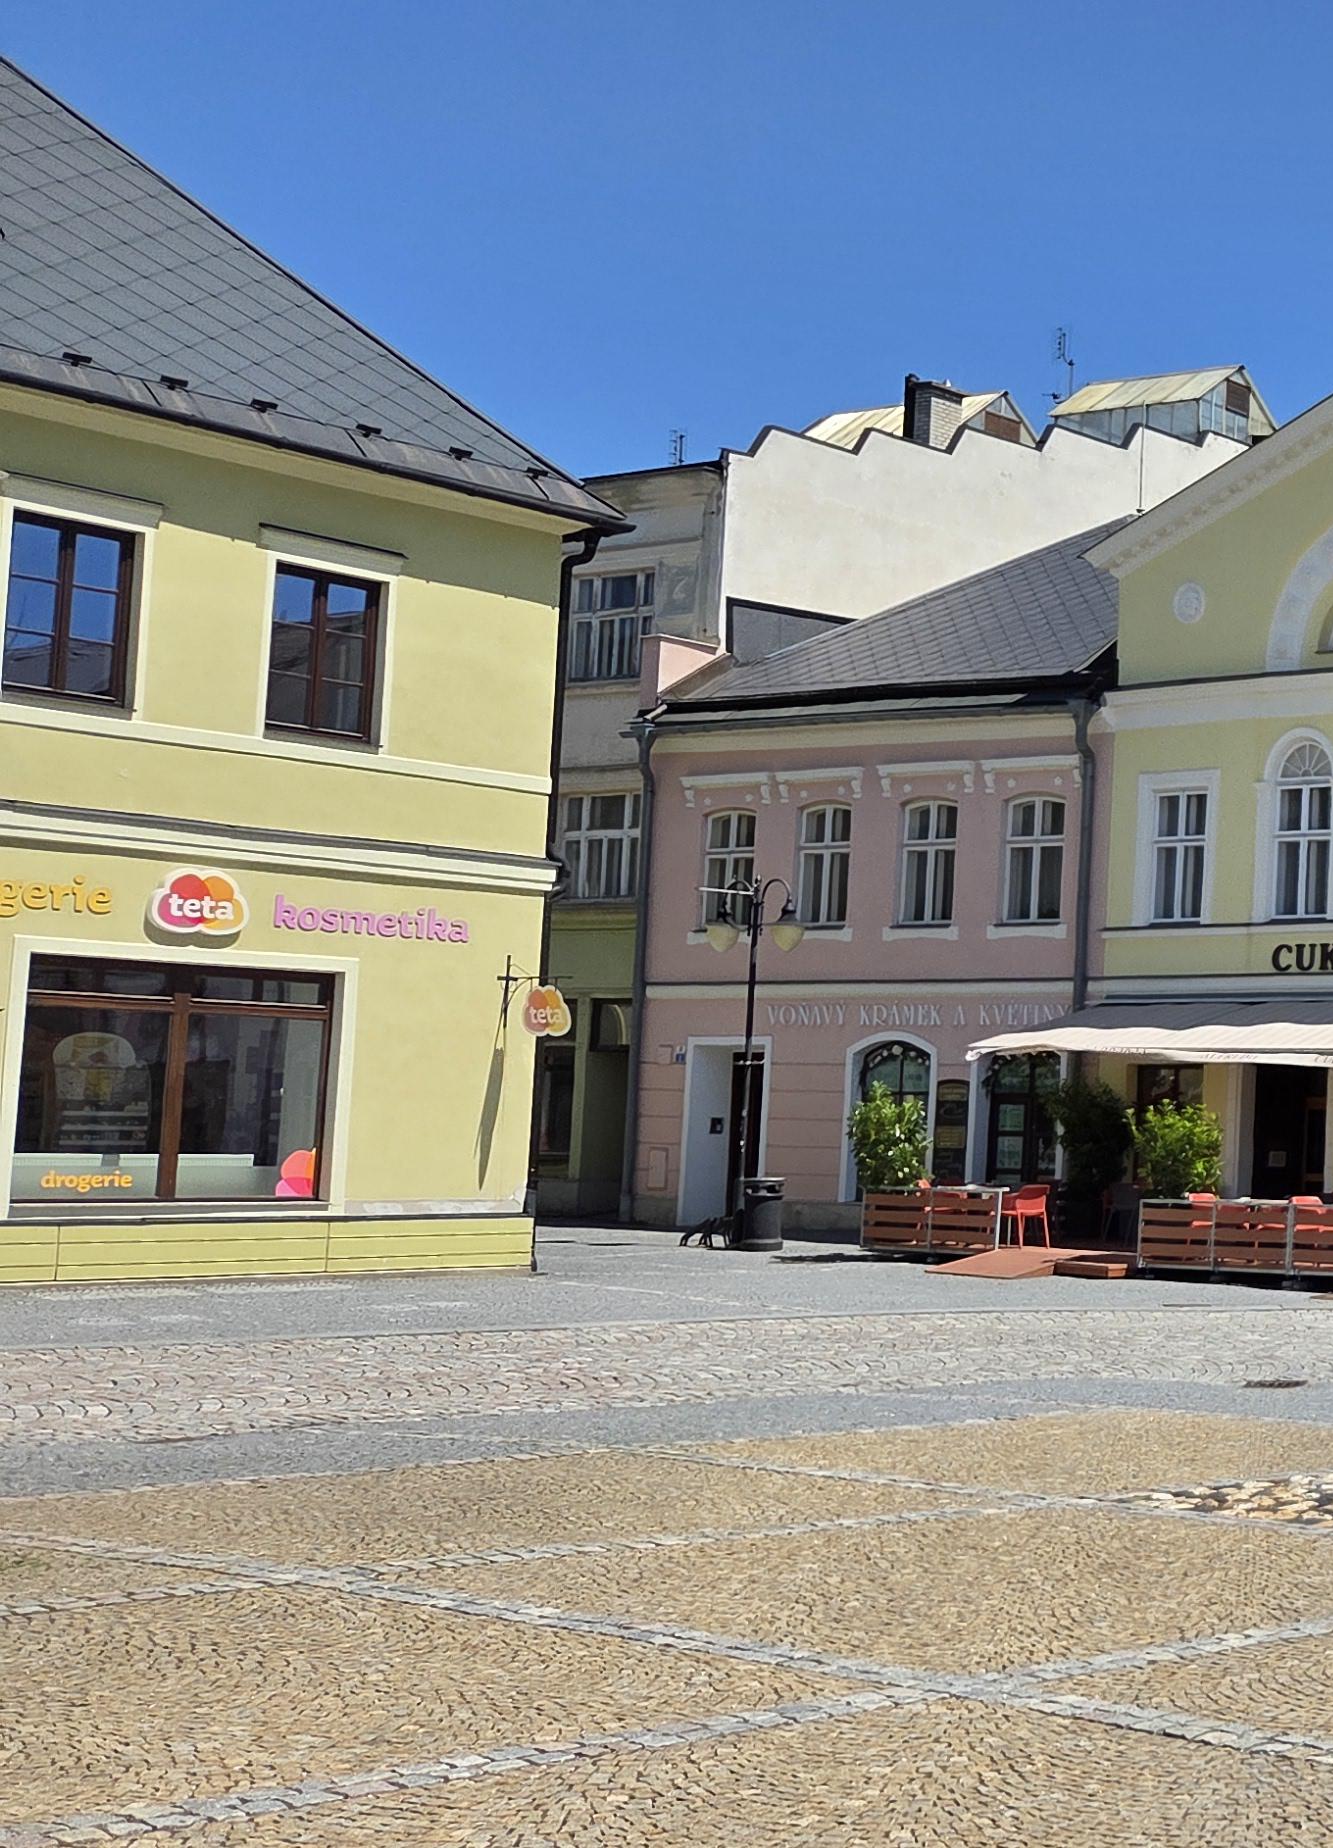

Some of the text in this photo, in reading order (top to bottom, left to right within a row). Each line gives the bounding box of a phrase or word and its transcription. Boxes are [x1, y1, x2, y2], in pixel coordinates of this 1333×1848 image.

[168, 893, 234, 920] teta
[273, 894, 470, 943] kosmetika
[529, 1005, 564, 1025] teta
[766, 1001, 847, 1025] VOŇAVÝ
[859, 1001, 942, 1025] KRÁMEK
[953, 1005, 966, 1025] A
[40, 1169, 133, 1194] drogerie
